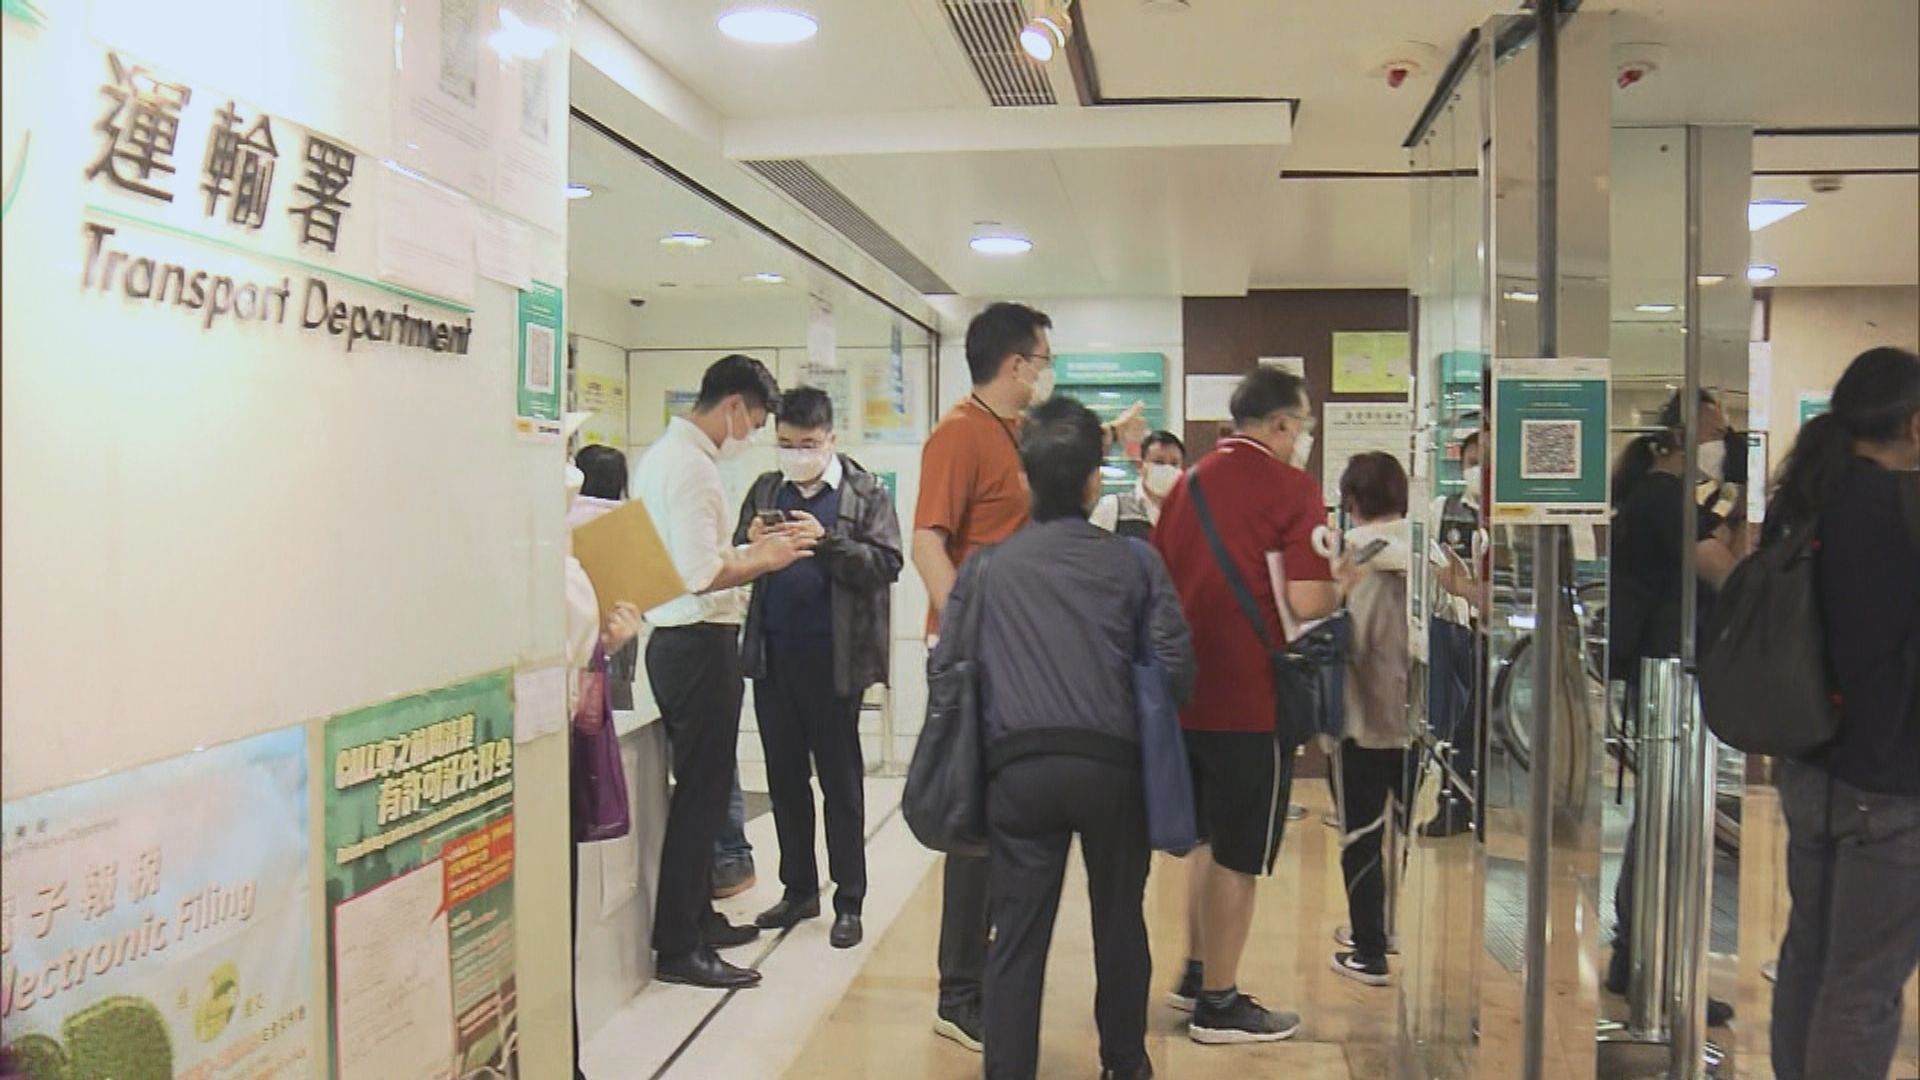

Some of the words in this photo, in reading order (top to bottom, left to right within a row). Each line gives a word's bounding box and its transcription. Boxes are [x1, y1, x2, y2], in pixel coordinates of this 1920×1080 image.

[84, 51, 357, 253] 運輸署
[81, 222, 291, 330] Transport
[302, 277, 473, 353] Department
[2, 913, 167, 1018] lectronic
[175, 878, 257, 941] Filing
